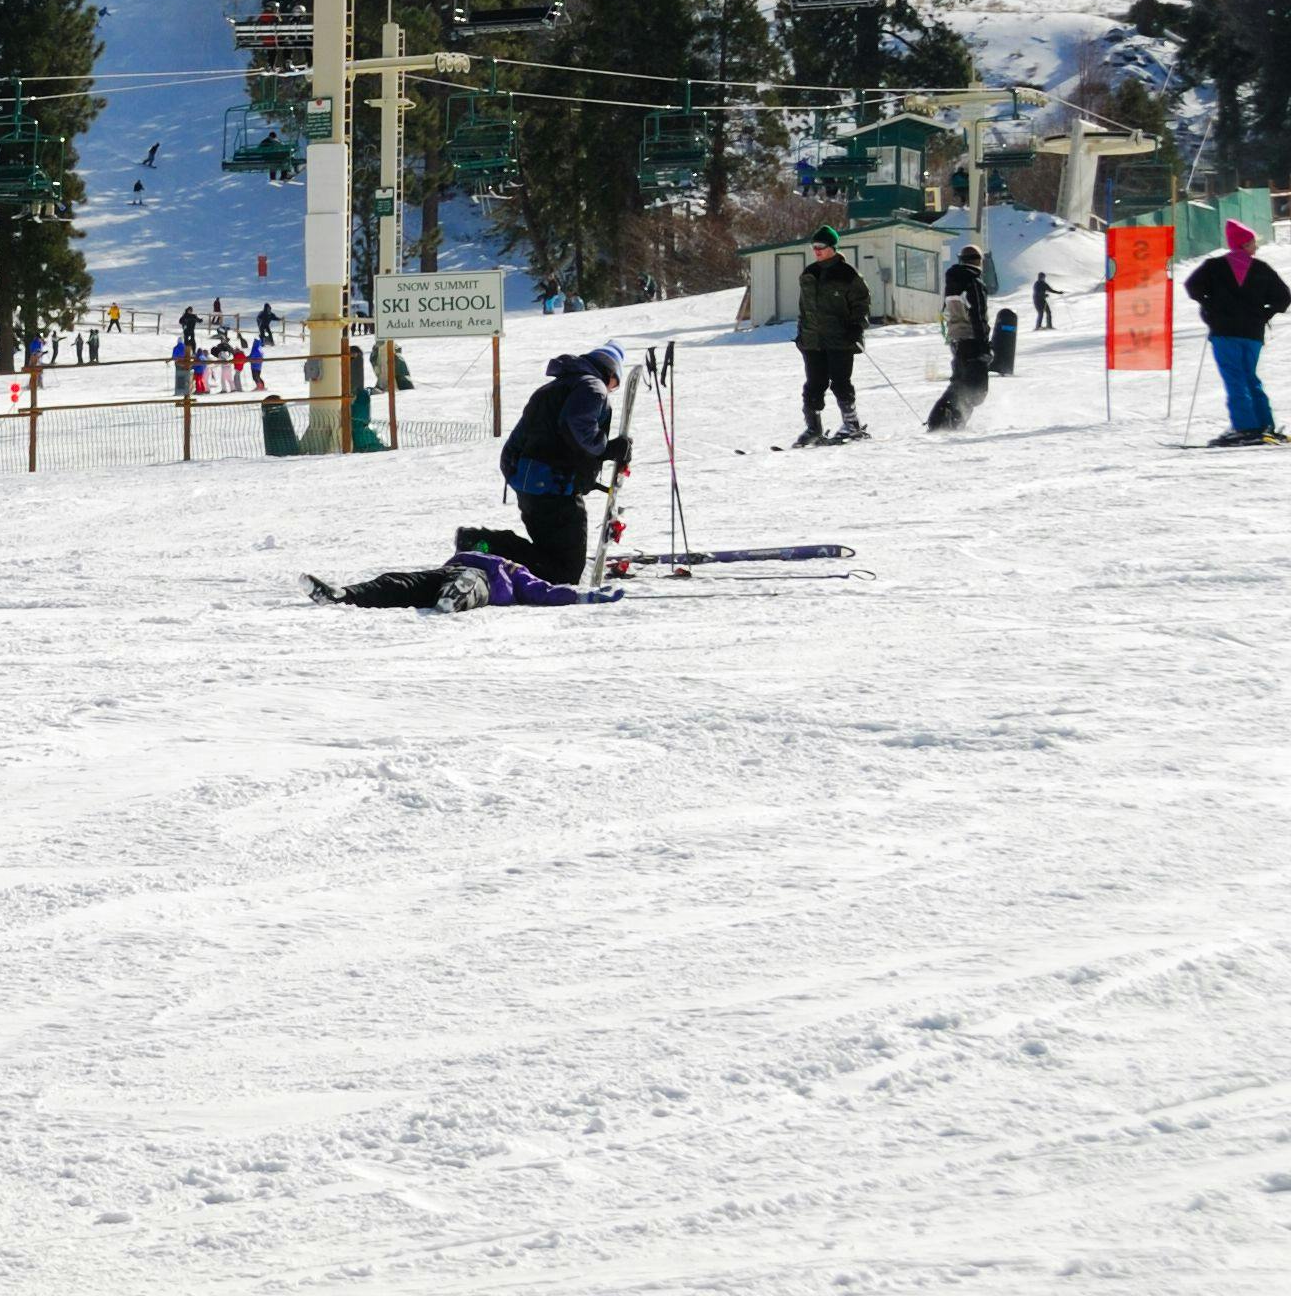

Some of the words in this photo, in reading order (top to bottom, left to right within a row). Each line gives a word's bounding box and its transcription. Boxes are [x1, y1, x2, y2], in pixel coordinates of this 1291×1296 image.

[397, 281, 430, 292] SNOW
[434, 280, 479, 291] SUMMIT
[382, 298, 409, 314] SKI
[418, 295, 496, 313] SCHOOL
[386, 318, 414, 329] Adult
[419, 317, 463, 329] Meeting
[467, 316, 492, 326] Area
